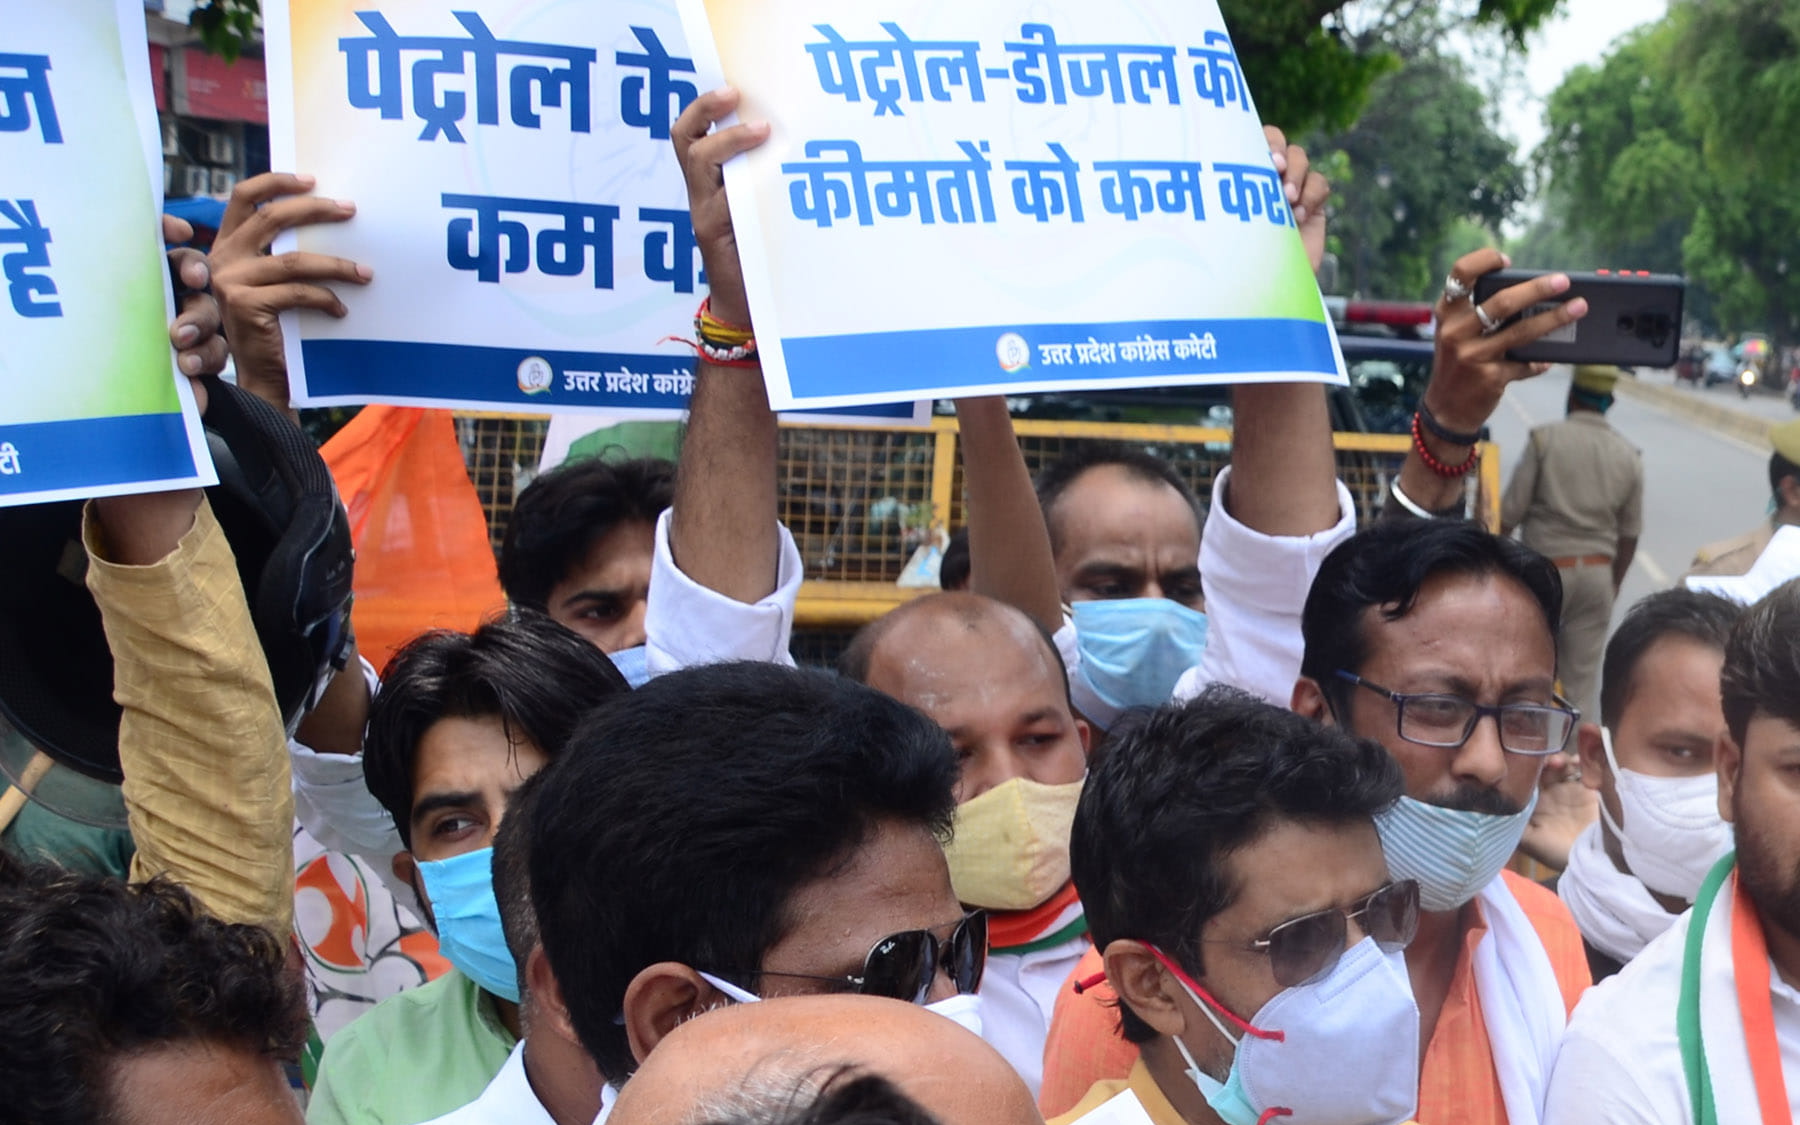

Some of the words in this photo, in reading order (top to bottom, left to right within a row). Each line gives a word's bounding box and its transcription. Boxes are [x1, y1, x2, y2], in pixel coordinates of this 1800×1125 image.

[338, 10, 597, 144] पेट्रोल
[804, 22, 1181, 116] पेट्रोल-डीजल
[1187, 30, 1250, 112] की
[781, 140, 997, 228] कीमतों
[1004, 142, 1085, 223] को
[1093, 161, 1206, 222] कम
[441, 192, 620, 290] कम
[563, 370, 602, 392] उत्तर
[604, 366, 650, 394] प्रदेश
[652, 368, 696, 395] कांग्रे
[1038, 343, 1073, 365] उत्तर
[1074, 336, 1117, 364] प्रदेश
[1118, 334, 1171, 362] कांग्रेस
[1172, 332, 1218, 360] कमेटी
